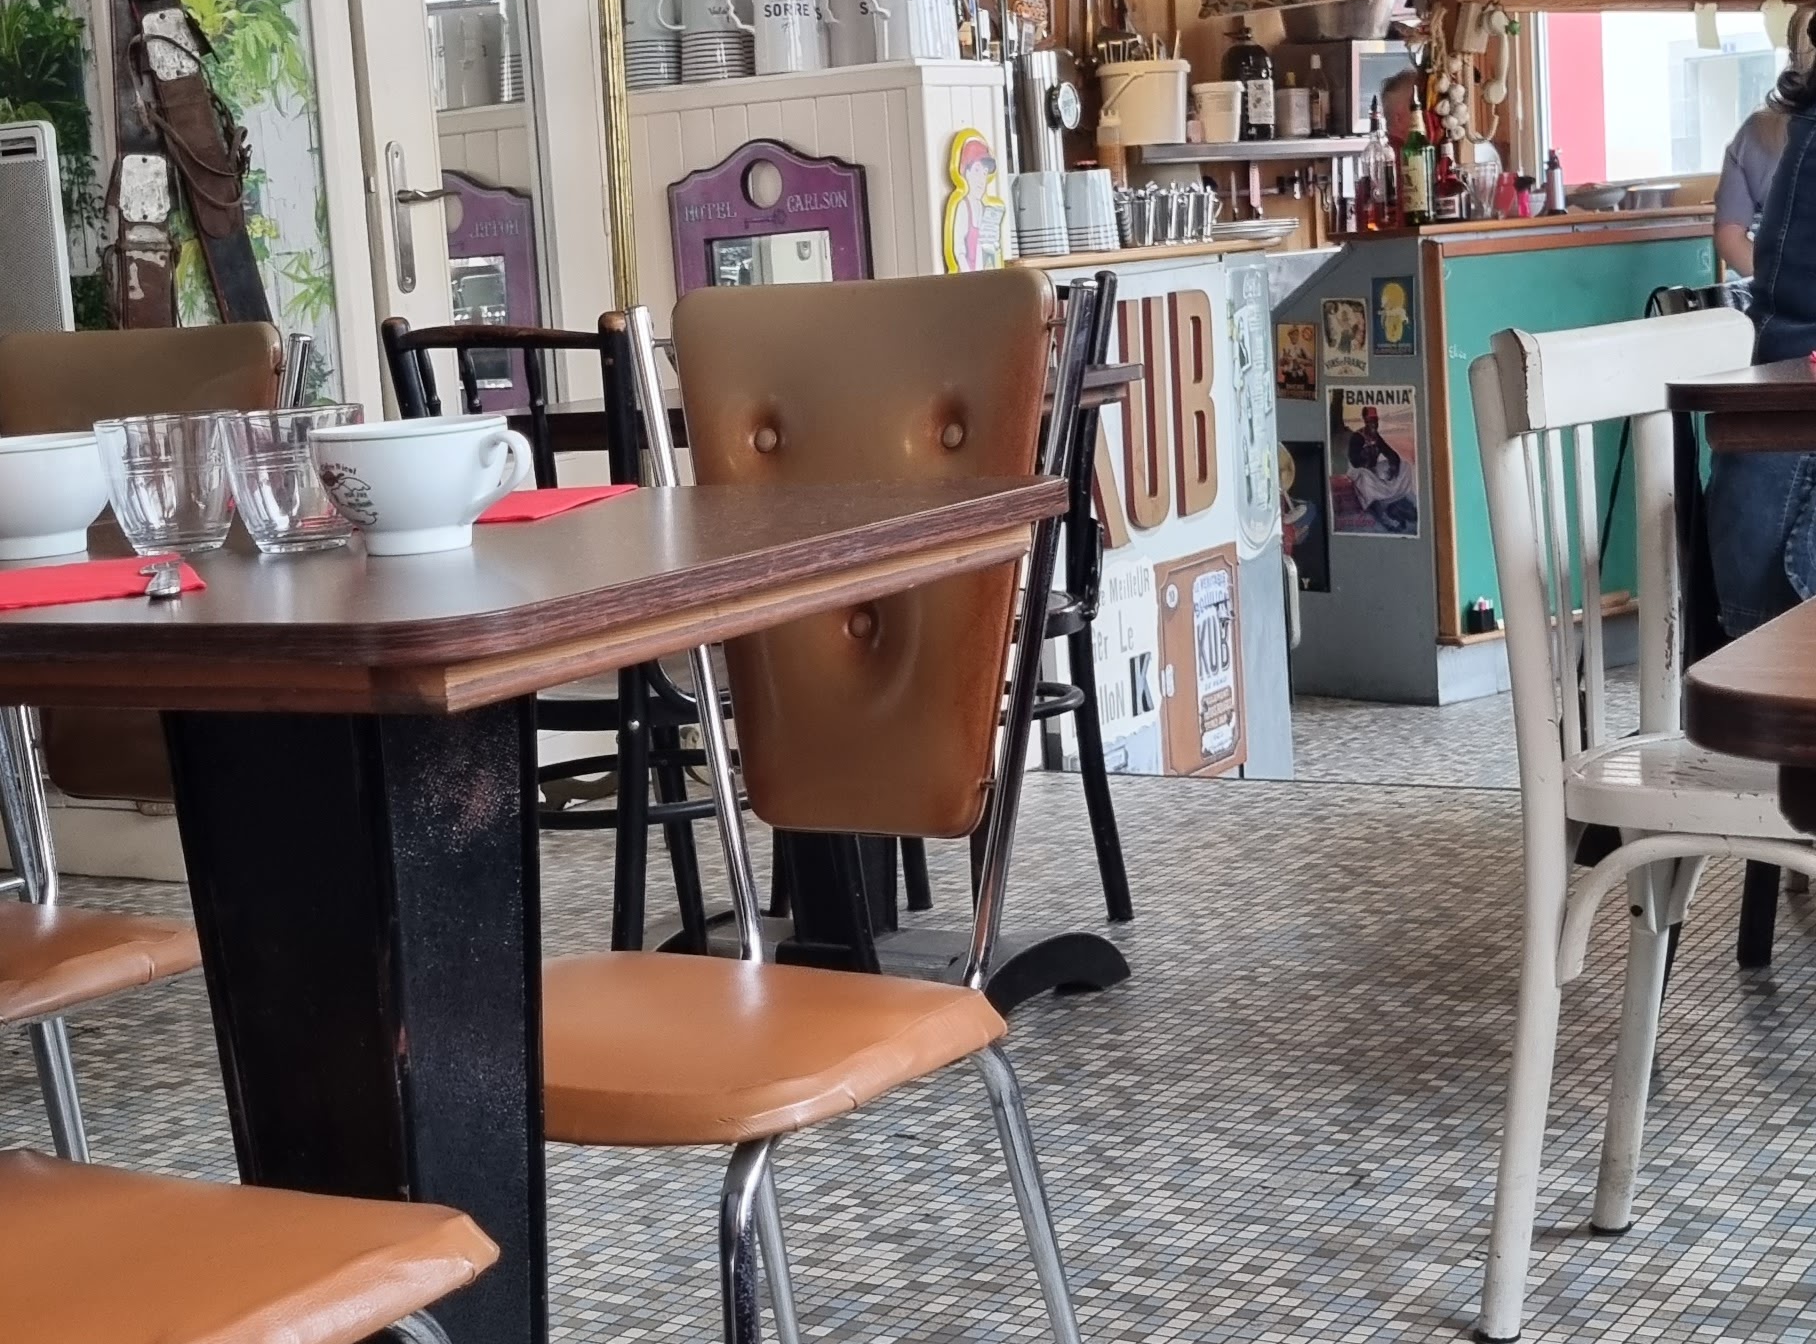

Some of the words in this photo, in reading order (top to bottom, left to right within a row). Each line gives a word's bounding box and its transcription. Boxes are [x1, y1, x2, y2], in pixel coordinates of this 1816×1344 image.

[685, 202, 737, 222] HOTEL
[786, 190, 848, 213] CARLSON
[1345, 389, 1411, 405] BANANIA
[1197, 615, 1230, 681] KUB
[1129, 651, 1155, 718] K
